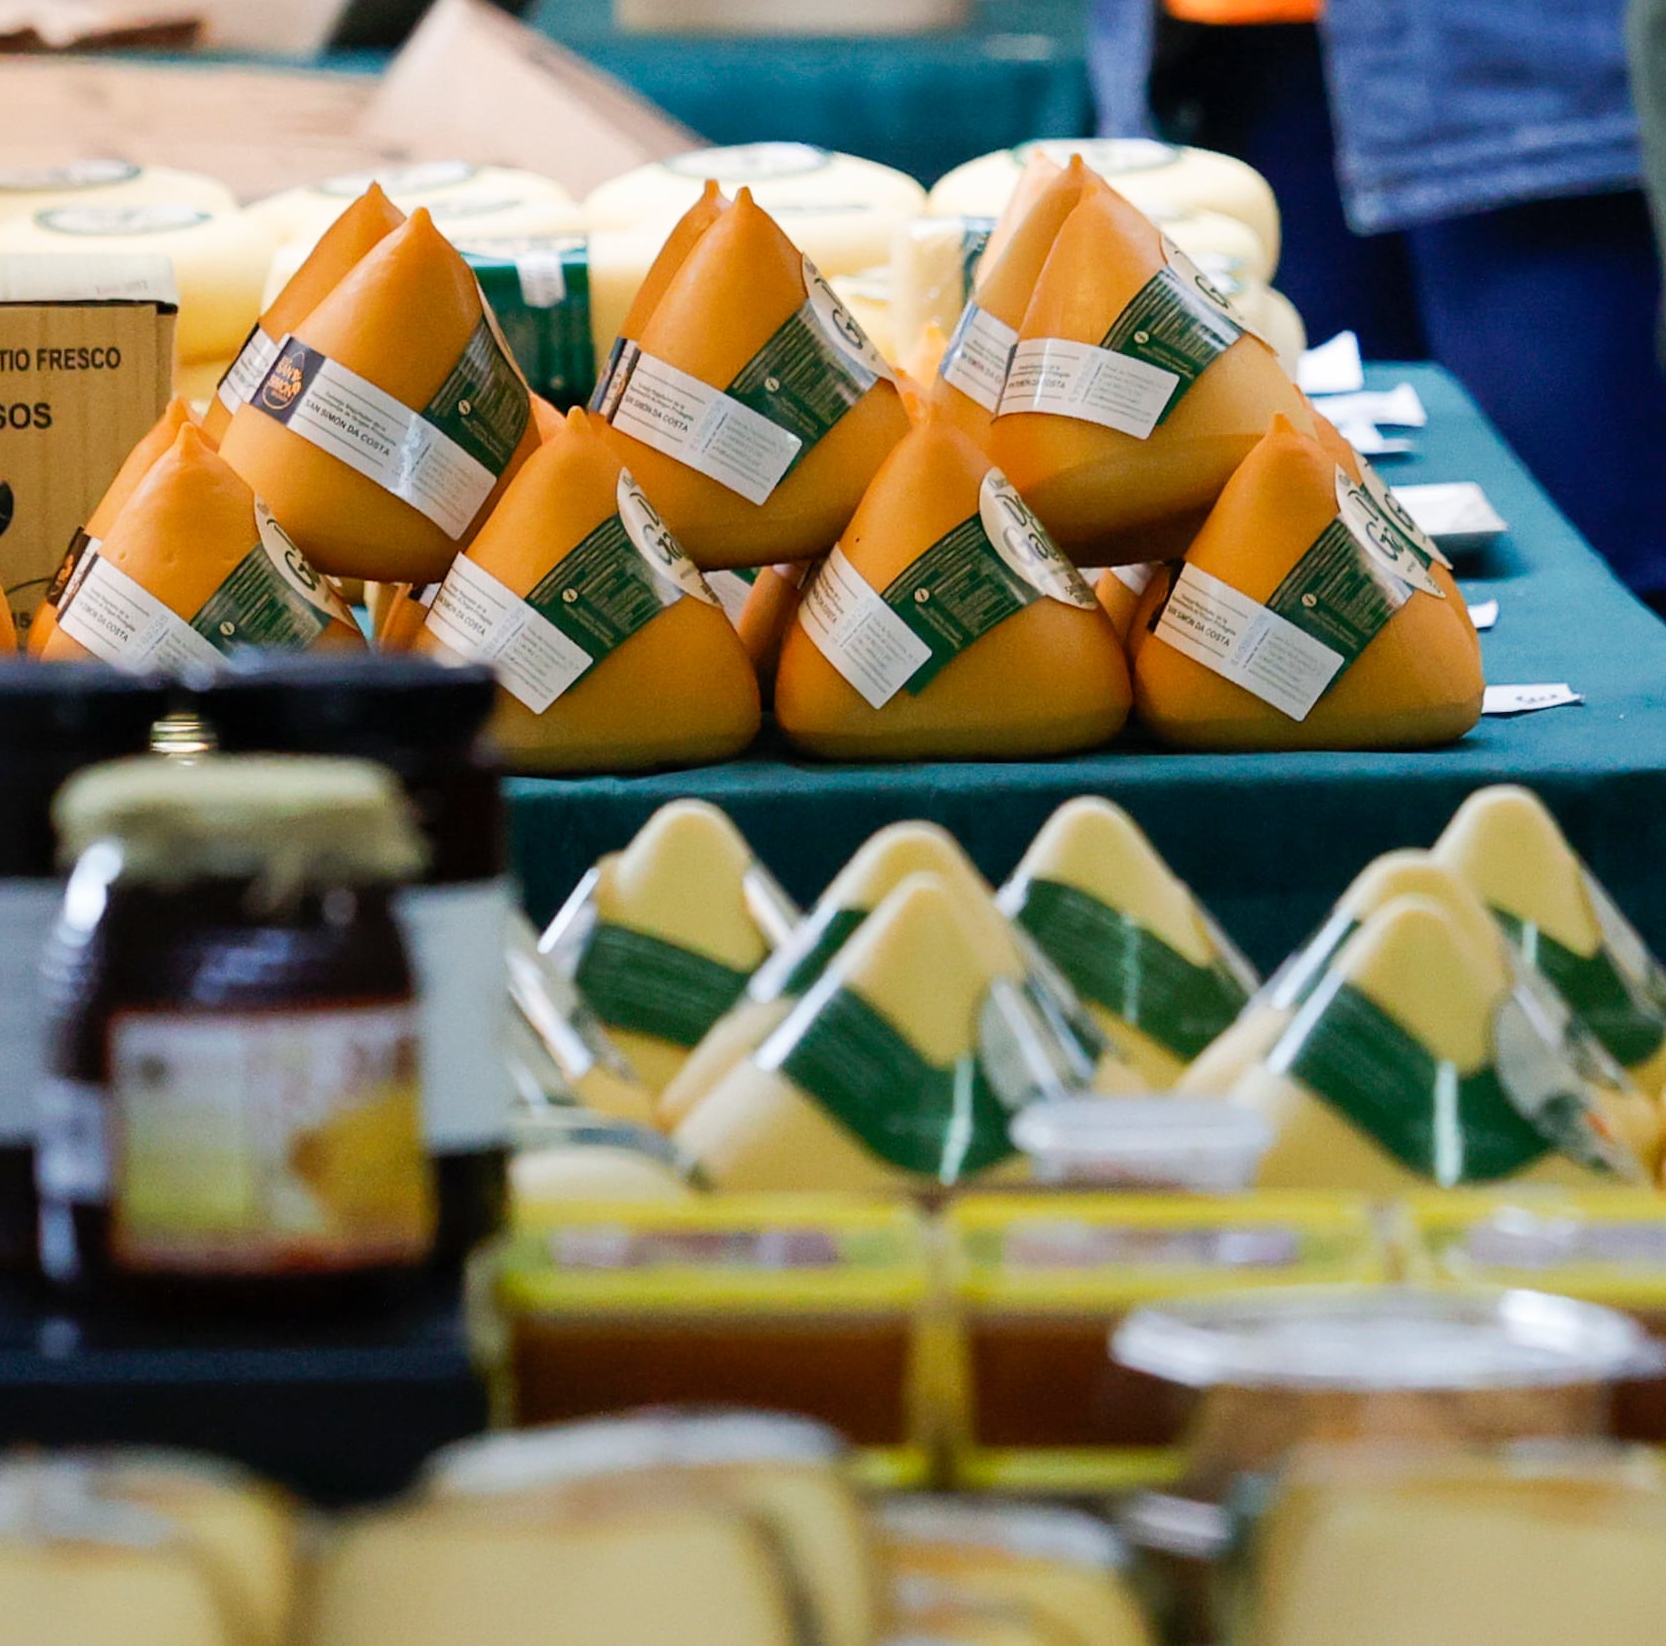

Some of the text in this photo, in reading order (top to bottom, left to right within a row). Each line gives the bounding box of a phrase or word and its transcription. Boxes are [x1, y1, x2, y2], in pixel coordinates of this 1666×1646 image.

[36, 347, 121, 370] FRESCO
[662, 414, 690, 433] COSTA
[346, 425, 361, 437] DA
[359, 432, 392, 457] COSTA
[105, 621, 130, 642] COSTA
[463, 616, 487, 636] COSTA
[1194, 621, 1206, 633] DA
[1204, 627, 1232, 647] COSTA
